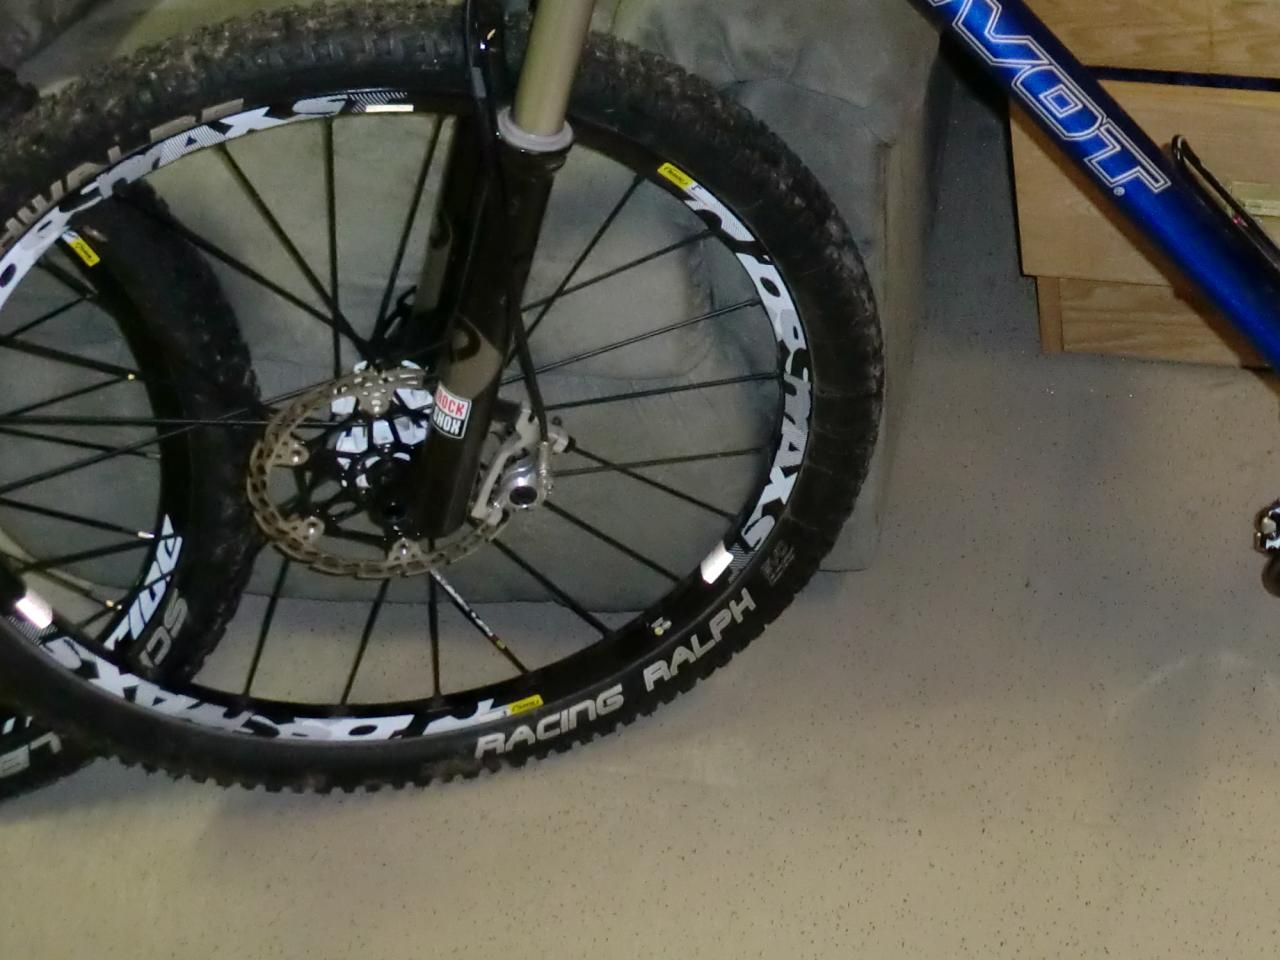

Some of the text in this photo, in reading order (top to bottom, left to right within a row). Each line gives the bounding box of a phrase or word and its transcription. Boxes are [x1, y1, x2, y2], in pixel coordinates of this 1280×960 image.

[436, 389, 466, 417] ROCK
[474, 586, 757, 760] RACING RALPH
